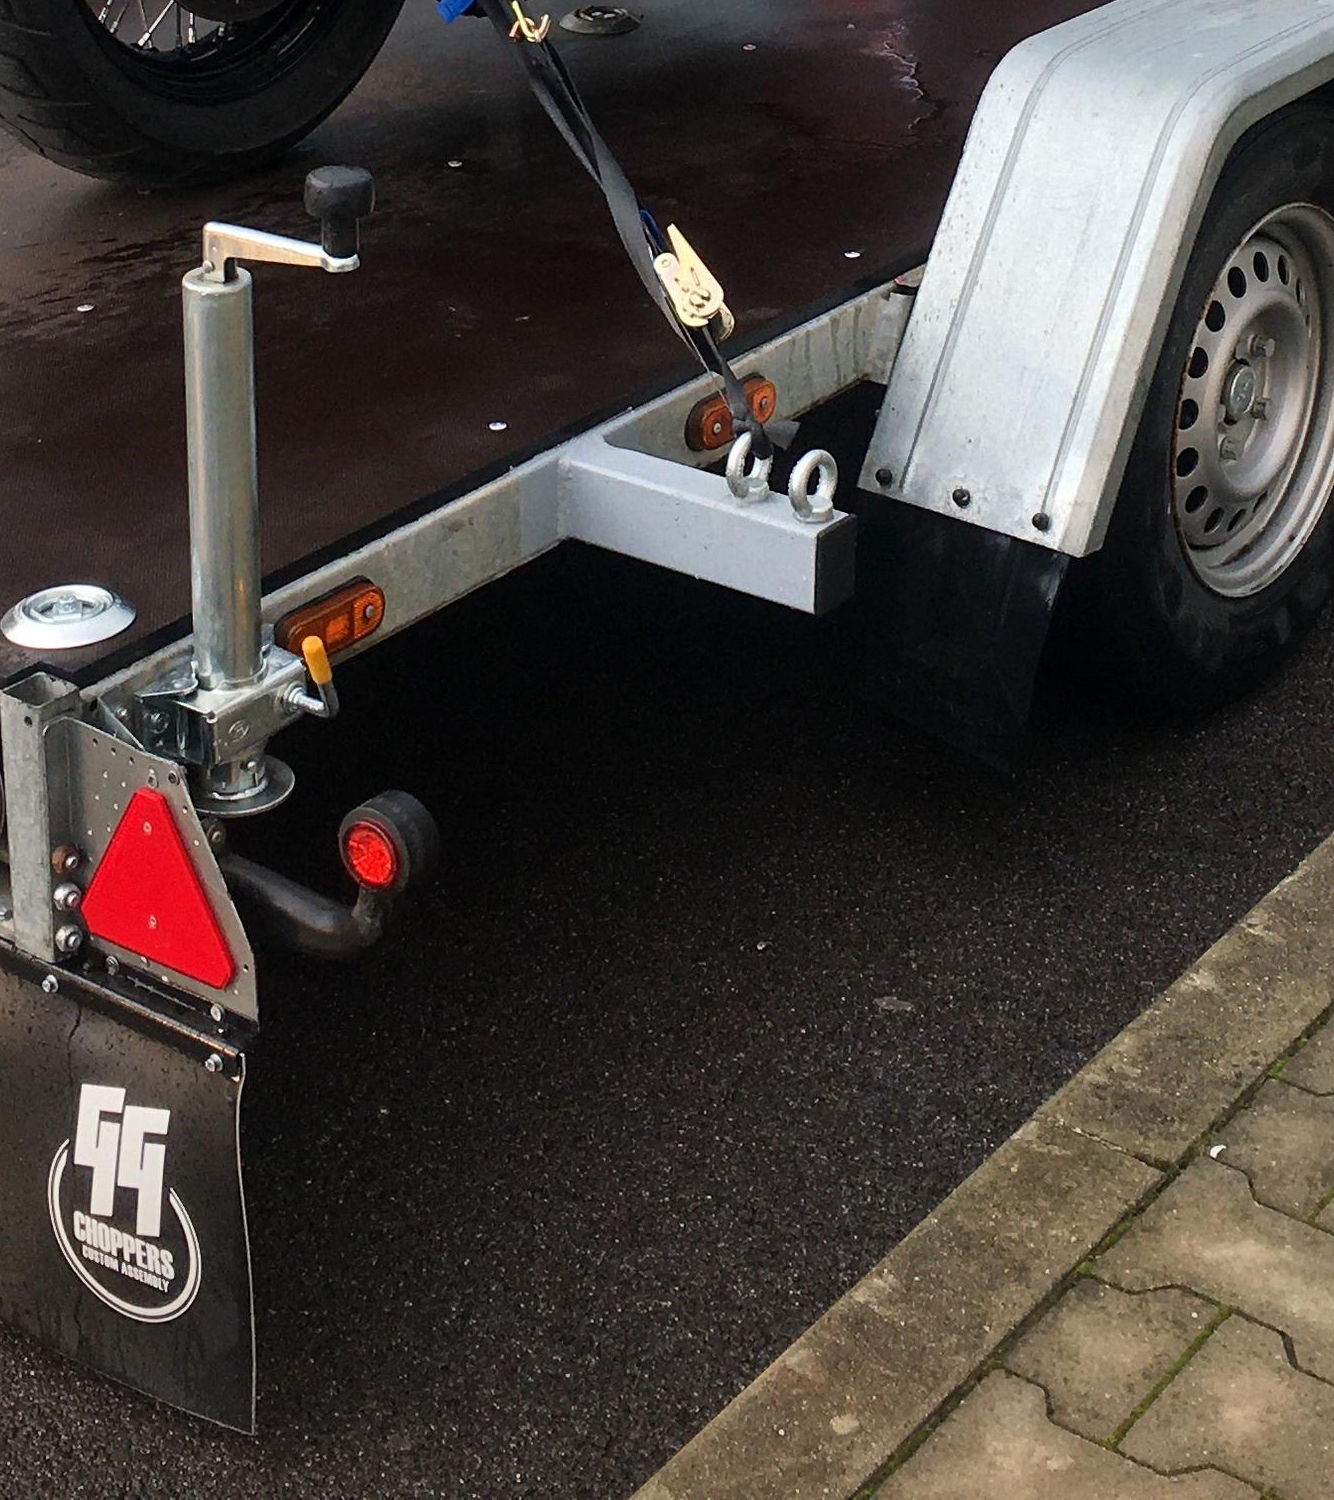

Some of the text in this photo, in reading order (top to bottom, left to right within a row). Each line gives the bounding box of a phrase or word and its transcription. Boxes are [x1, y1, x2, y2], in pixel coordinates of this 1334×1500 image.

[73, 1210, 175, 1281] CHOPPERS
[82, 1244, 169, 1293] CUSTOM ASSEMBLY
